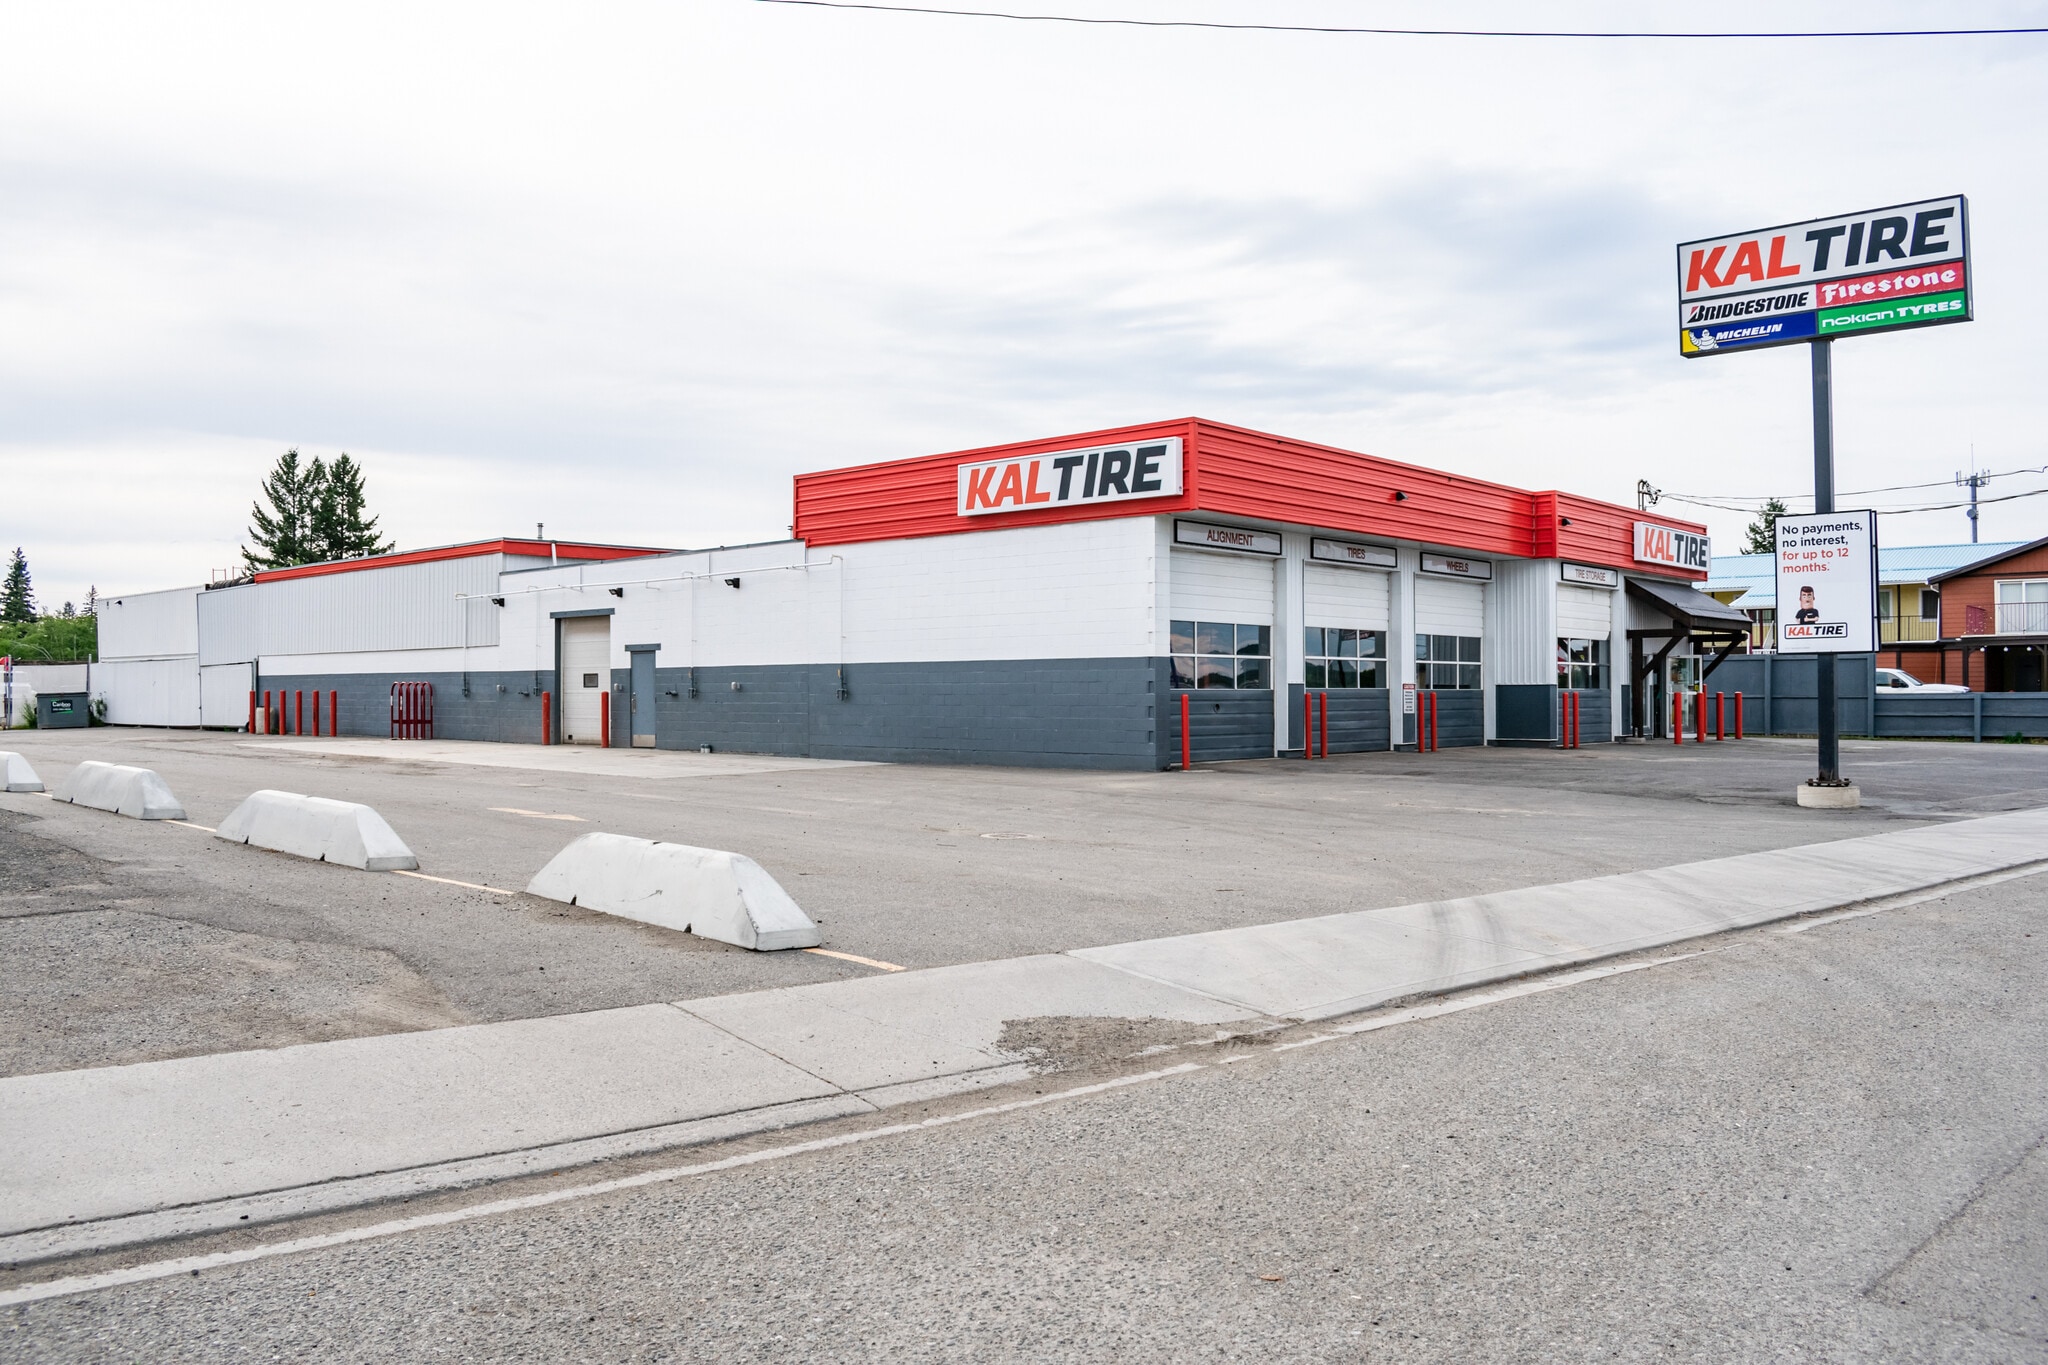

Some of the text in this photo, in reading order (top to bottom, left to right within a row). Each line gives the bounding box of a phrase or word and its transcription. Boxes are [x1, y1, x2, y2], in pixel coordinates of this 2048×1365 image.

[1821, 268, 1956, 304] Firestone
[1687, 291, 1809, 323] BRIDGESTONE
[1822, 299, 1962, 328] nokian TYRES
[1715, 323, 1783, 340] MICHELIN
[1782, 521, 1863, 536] No payments,
[1206, 529, 1254, 546] ALIGNMENT
[1782, 535, 1849, 548] no interest,
[1347, 547, 1366, 559] TIRES
[1782, 548, 1849, 561] for up to 12
[1446, 560, 1469, 572] WHEELS
[1575, 568, 1606, 582] TIRE STORAGE
